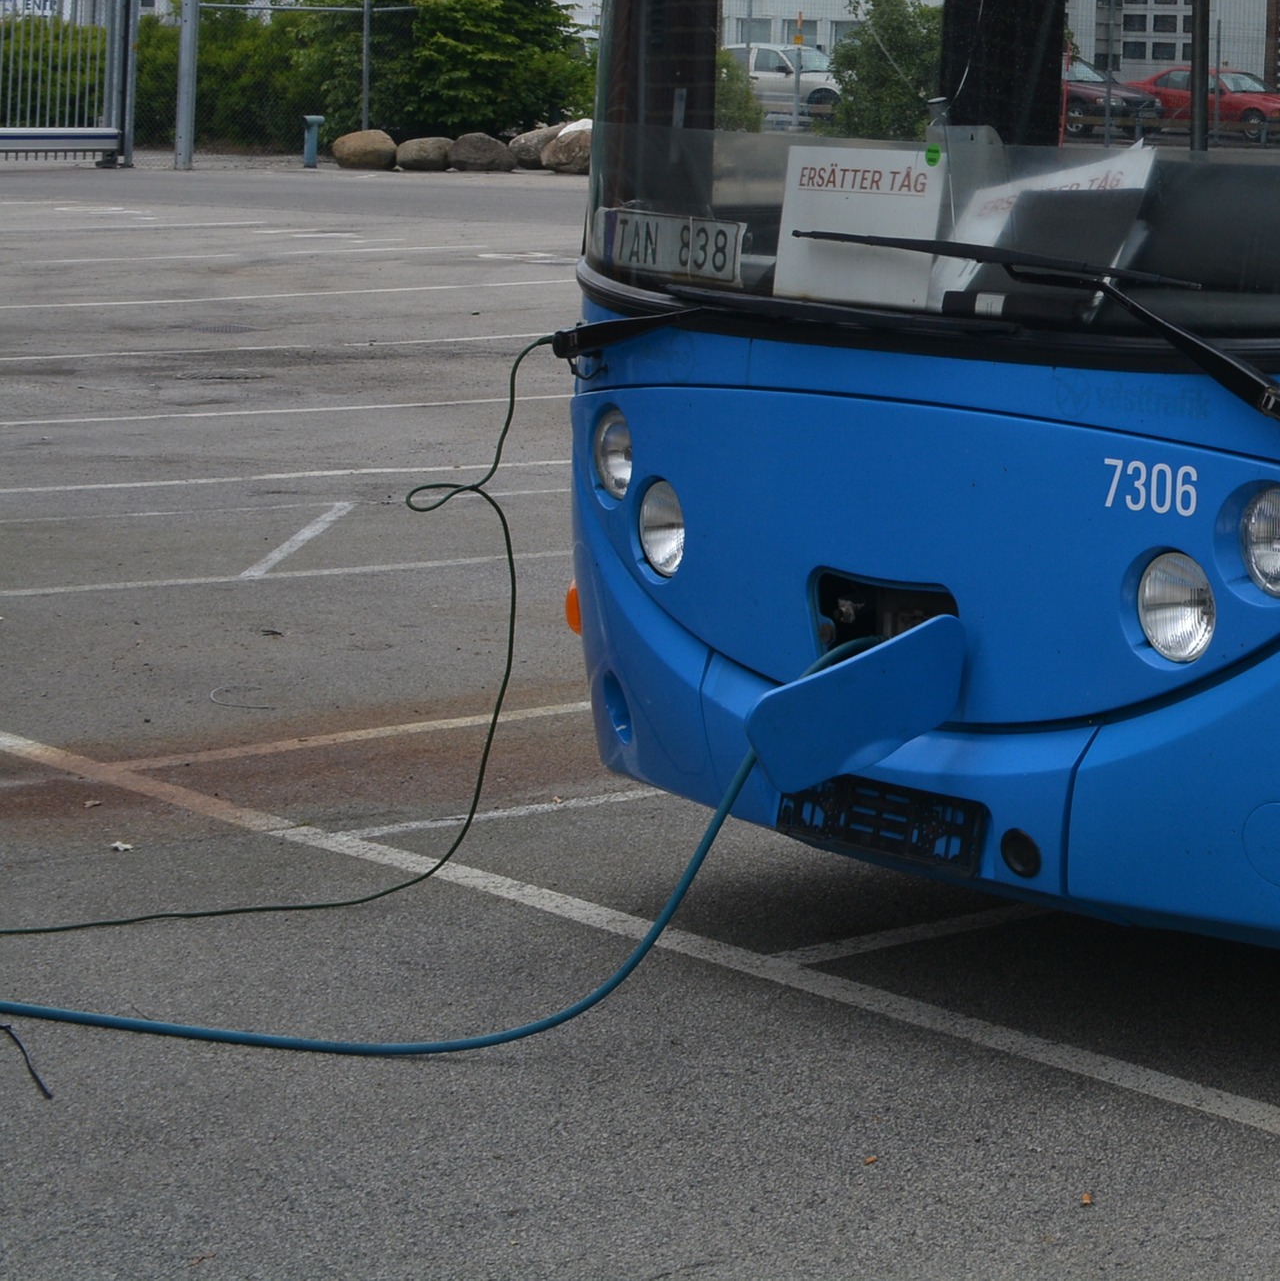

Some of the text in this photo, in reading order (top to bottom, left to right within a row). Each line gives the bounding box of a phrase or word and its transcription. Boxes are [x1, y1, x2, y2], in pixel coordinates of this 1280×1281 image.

[799, 163, 928, 193] ERSÄTTER TÅG
[619, 219, 728, 273] TAN 838
[1103, 457, 1198, 517] 7306
